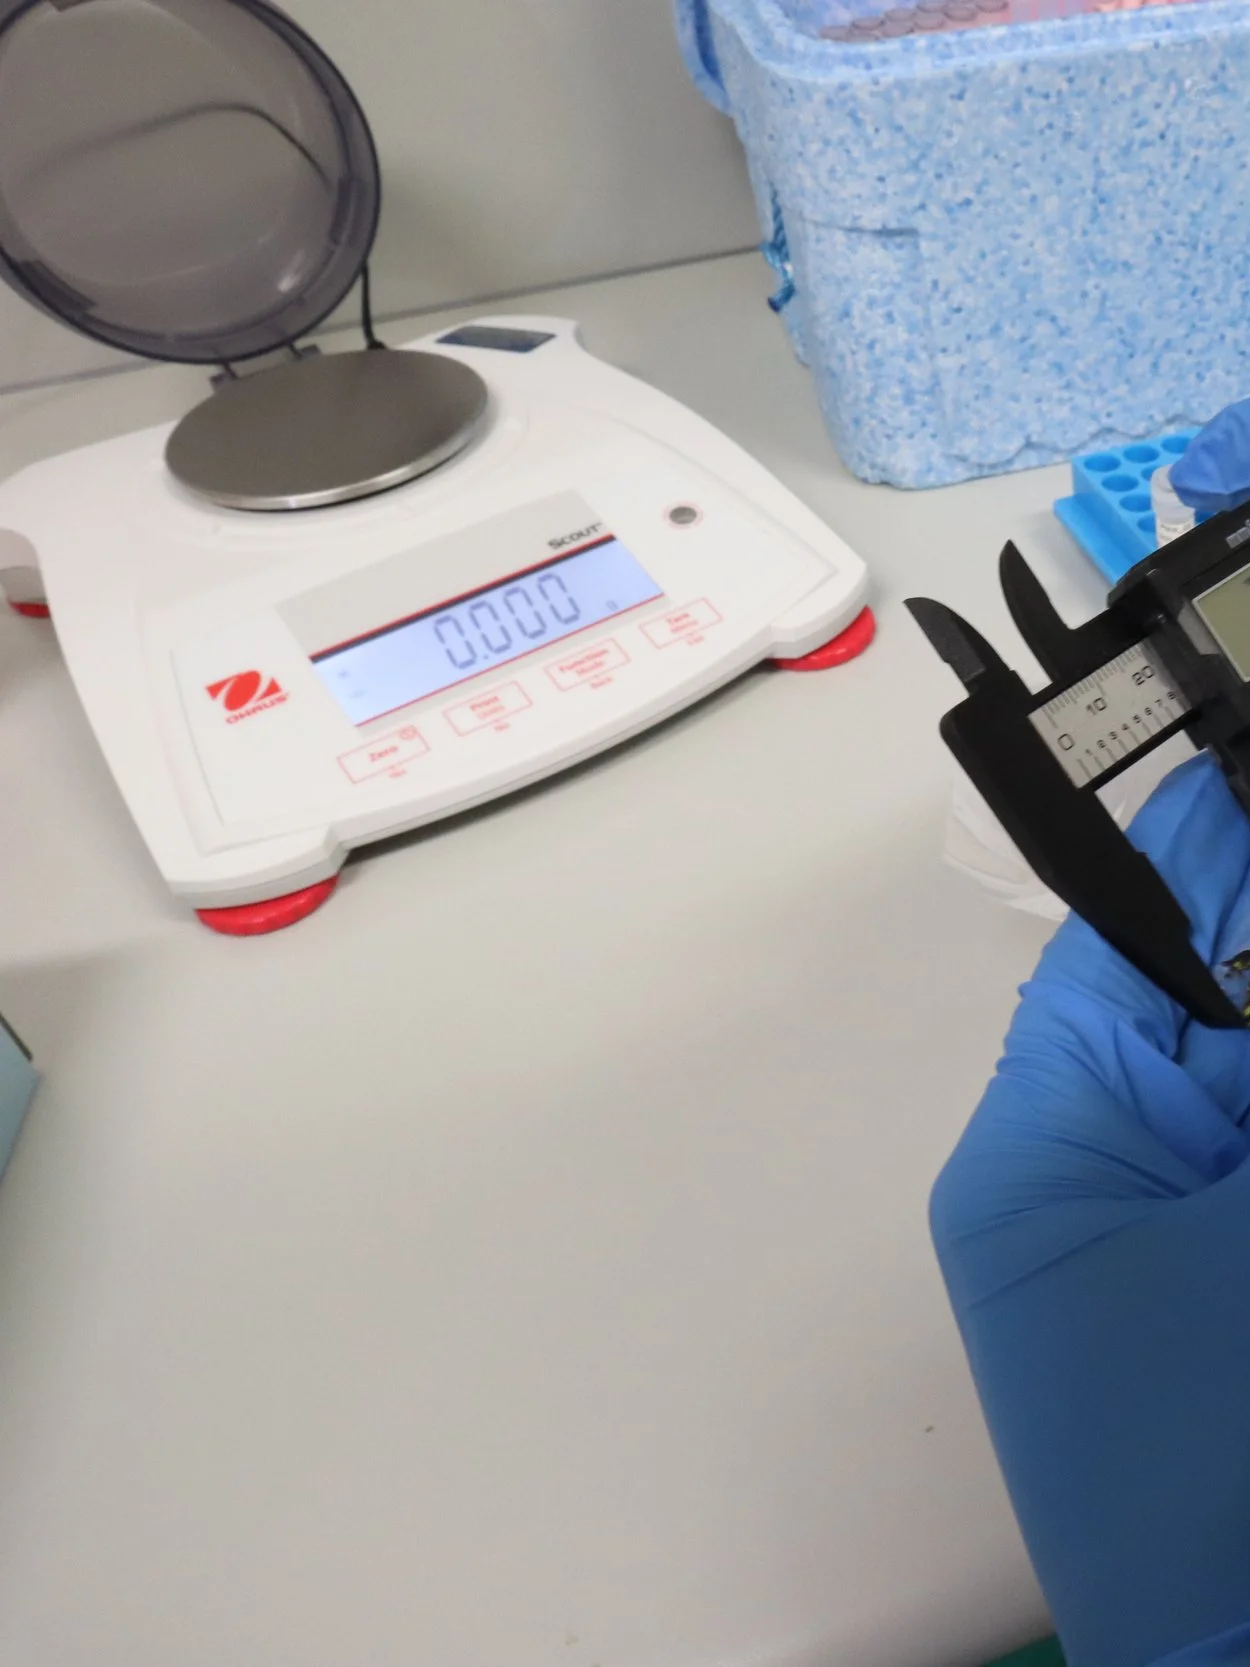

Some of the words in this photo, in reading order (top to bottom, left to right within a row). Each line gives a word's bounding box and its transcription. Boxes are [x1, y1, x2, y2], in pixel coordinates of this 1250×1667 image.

[434, 573, 581, 669] 0.000
[1057, 733, 1075, 751] 0
[1086, 697, 1107, 716] 10
[1132, 665, 1155, 686] 20
